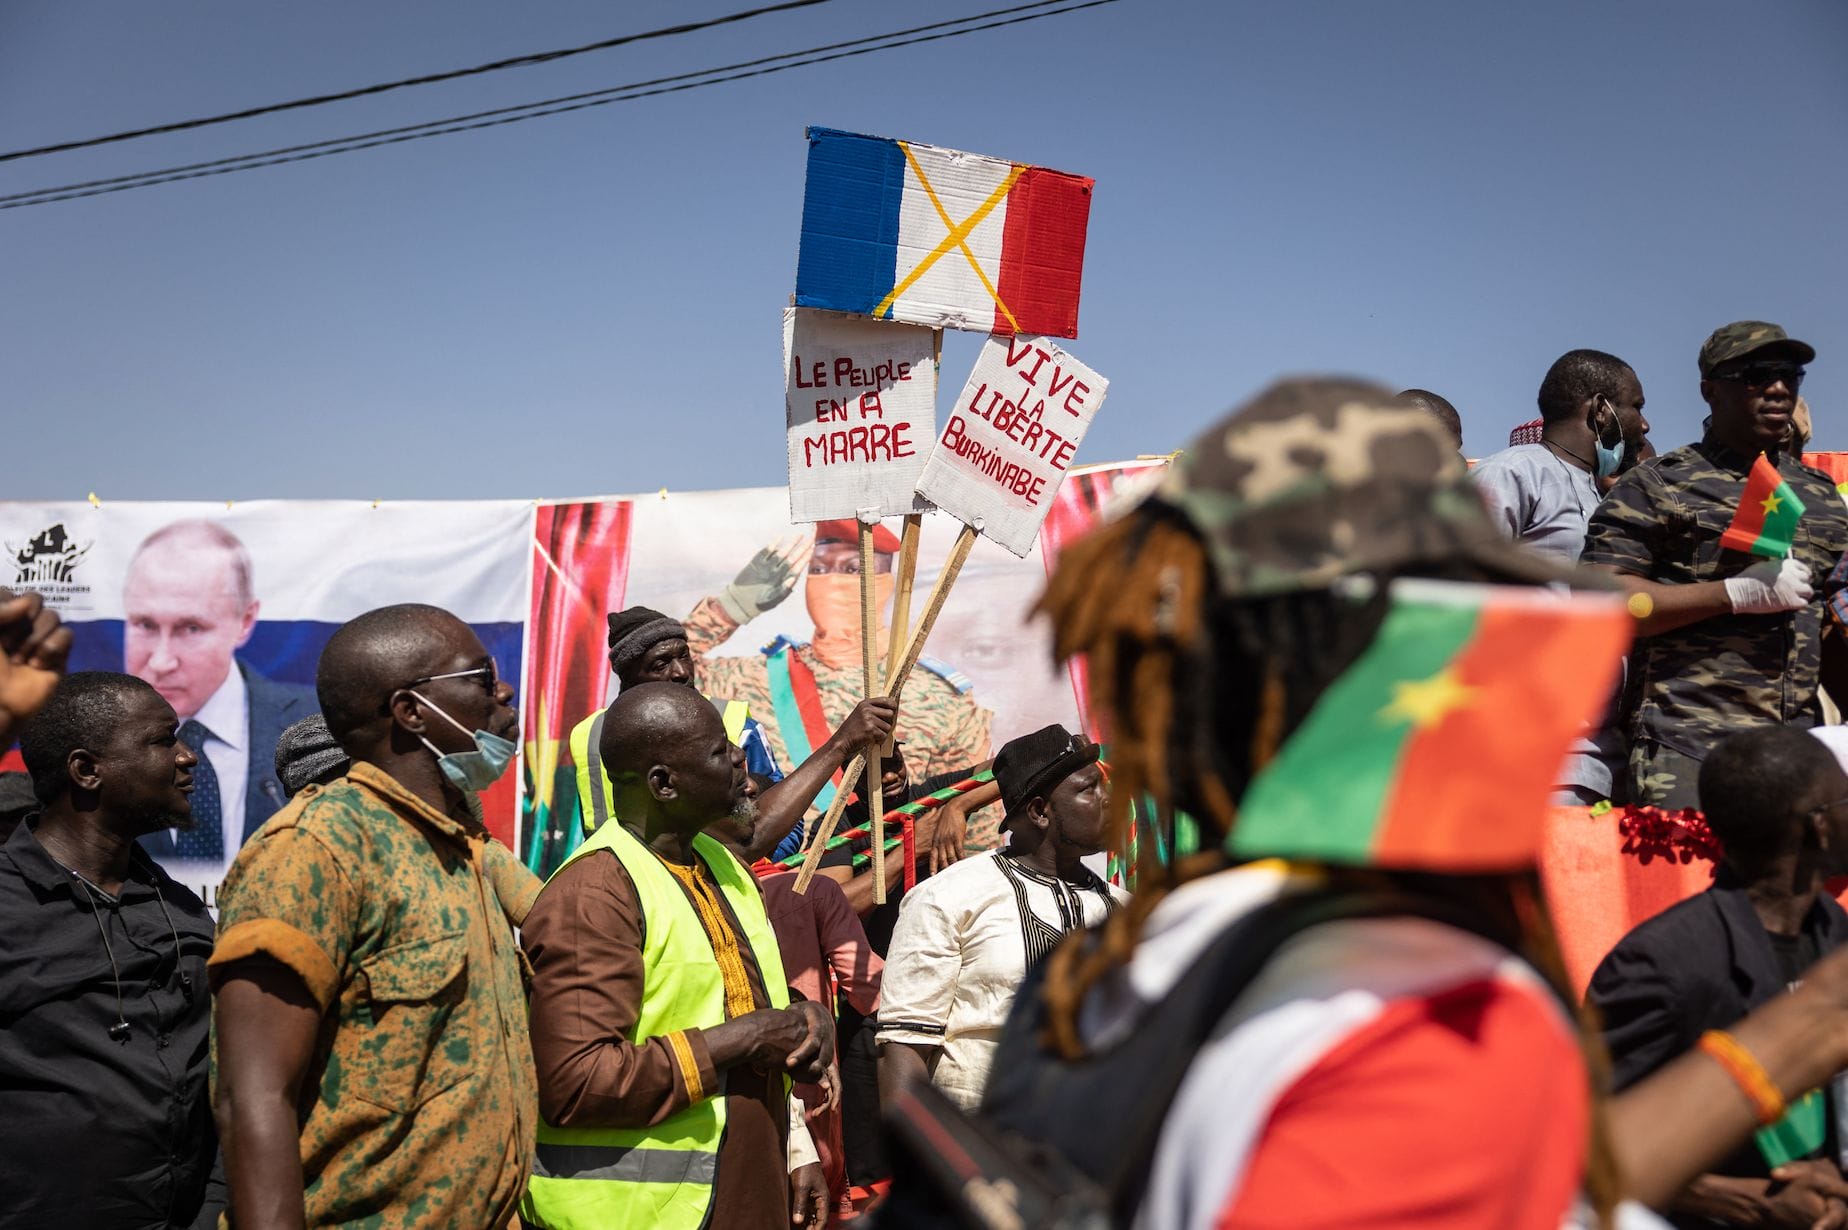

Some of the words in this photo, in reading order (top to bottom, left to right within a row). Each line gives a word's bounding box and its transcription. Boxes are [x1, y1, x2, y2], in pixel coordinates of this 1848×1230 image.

[795, 356, 826, 388] LE
[1005, 335, 1091, 418] VIVE
[816, 398, 848, 422] EN
[859, 389, 883, 420] A
[1016, 388, 1045, 421] LA
[803, 422, 916, 468] MARRE
